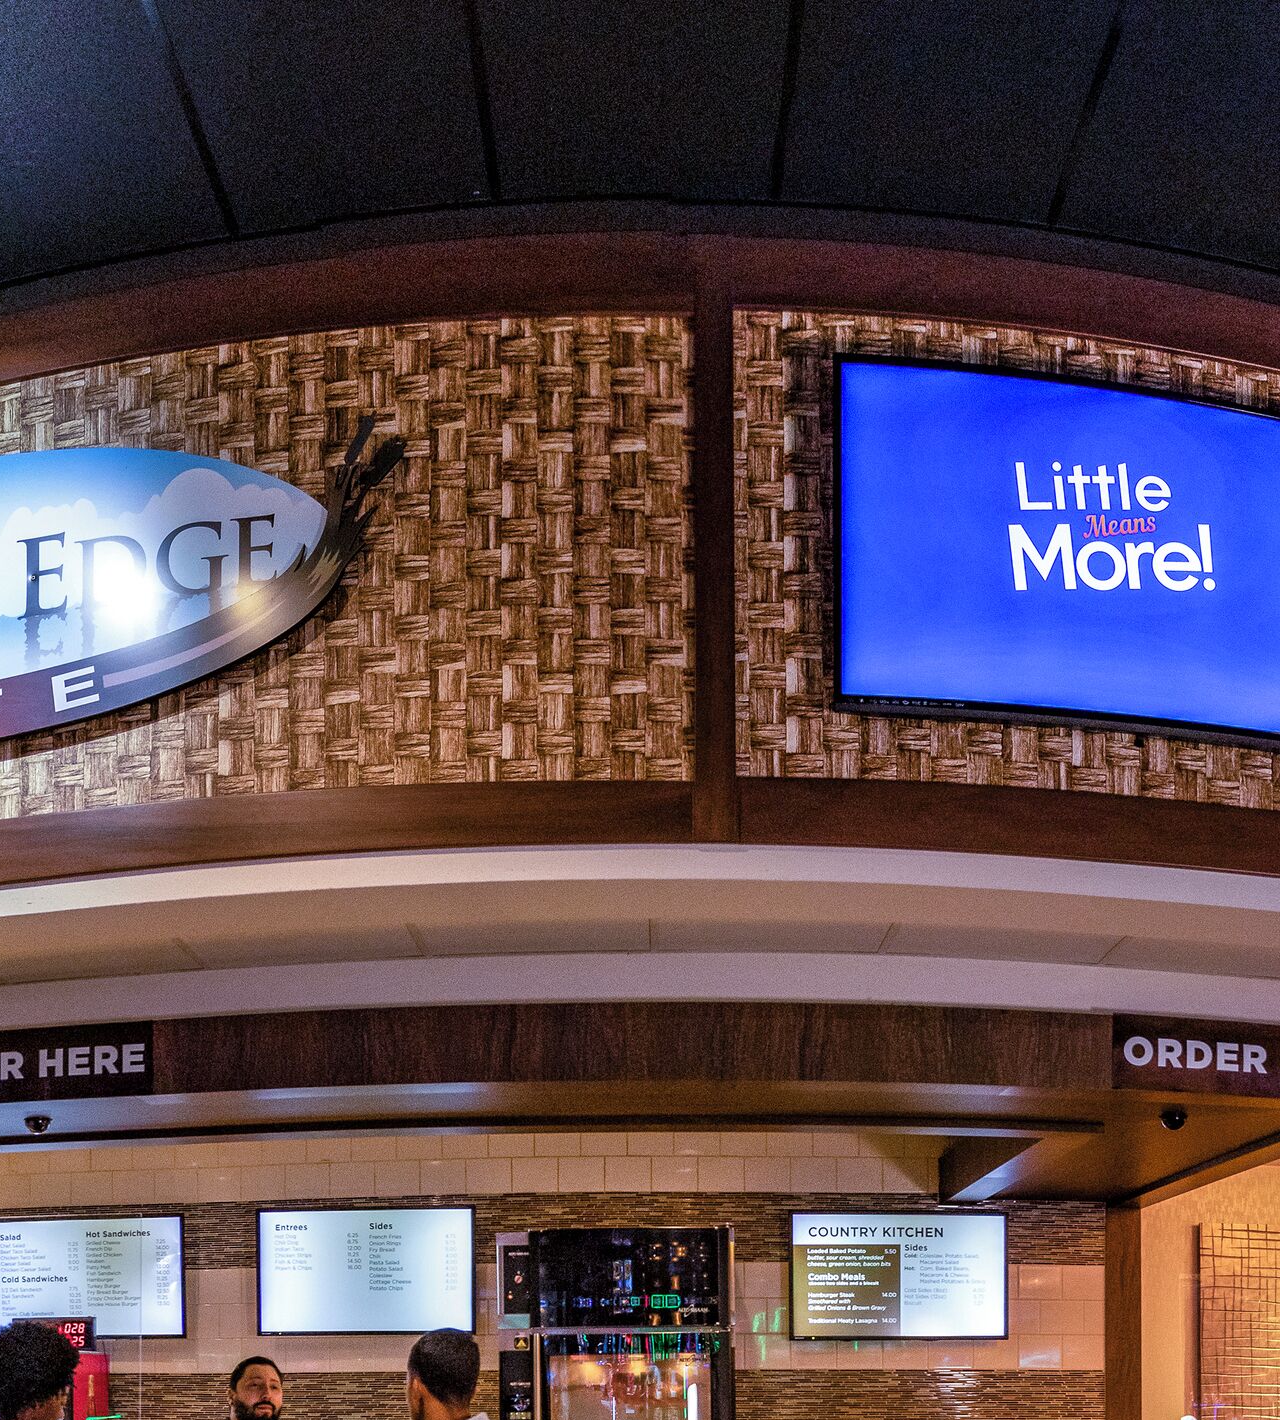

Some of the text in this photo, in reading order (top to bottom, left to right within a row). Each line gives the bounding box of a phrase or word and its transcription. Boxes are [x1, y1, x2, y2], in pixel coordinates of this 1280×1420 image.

[1015, 461, 1172, 512] Little
[1083, 514, 1156, 538] Means
[1008, 523, 1216, 591] More!
[38, 1043, 147, 1078] HERE
[1123, 1036, 1268, 1074] ORDER
[369, 1222, 393, 1230] Sides
[808, 1226, 944, 1238] COUNTRY KITCHEN
[0, 1233, 21, 1241] Salad
[102, 1229, 151, 1238] Sandwiches
[1, 1275, 68, 1284] Cold Sandwiches
[807, 1273, 866, 1281] Combo Meals
[64, 1322, 85, 1334] 028
